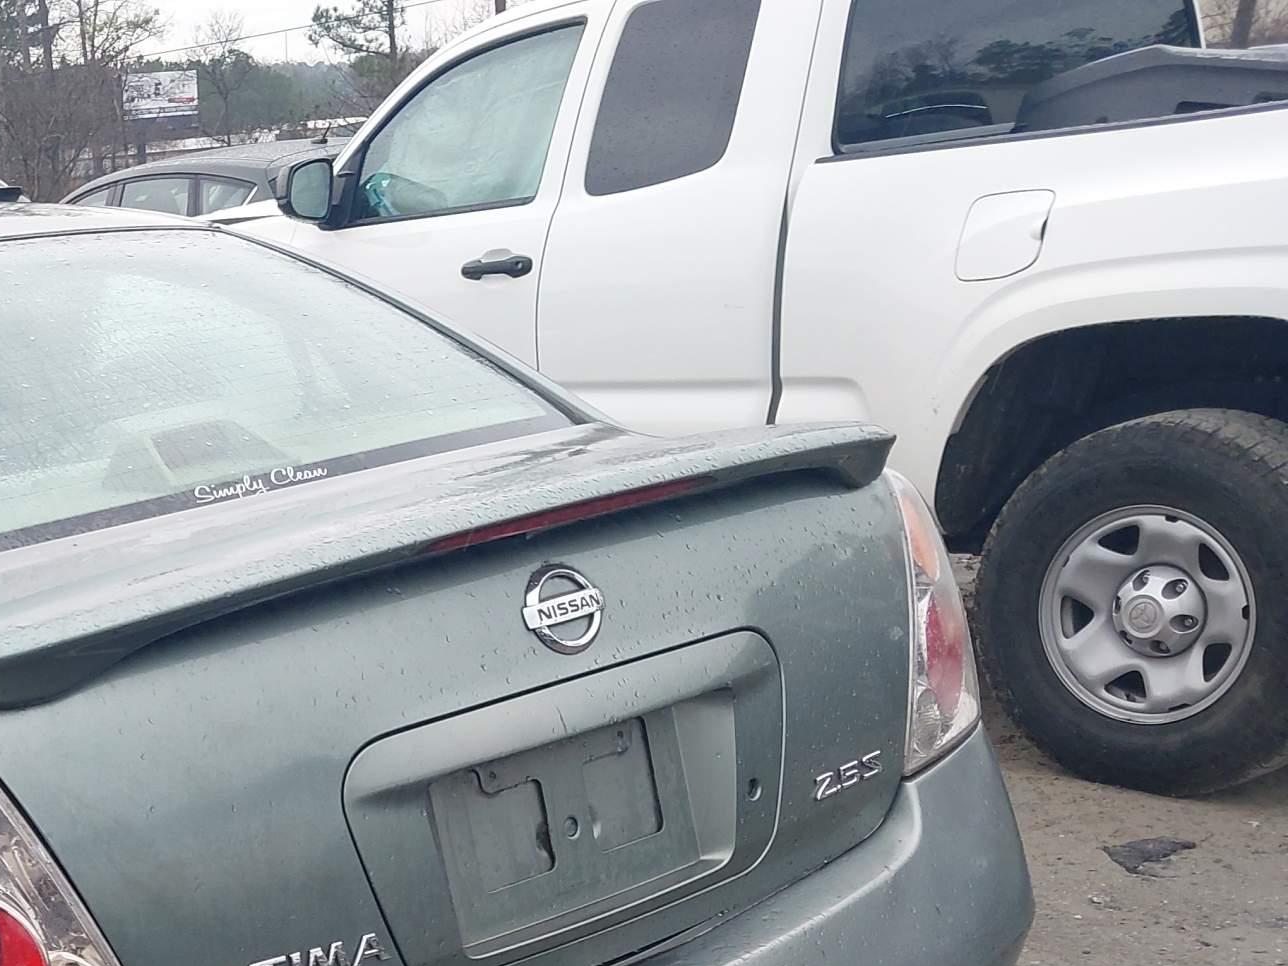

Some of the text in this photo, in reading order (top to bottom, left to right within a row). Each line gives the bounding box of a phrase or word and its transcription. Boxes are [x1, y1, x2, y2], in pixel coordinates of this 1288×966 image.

[194, 466, 328, 503] Simply Clean
[537, 592, 601, 622] NISSAN
